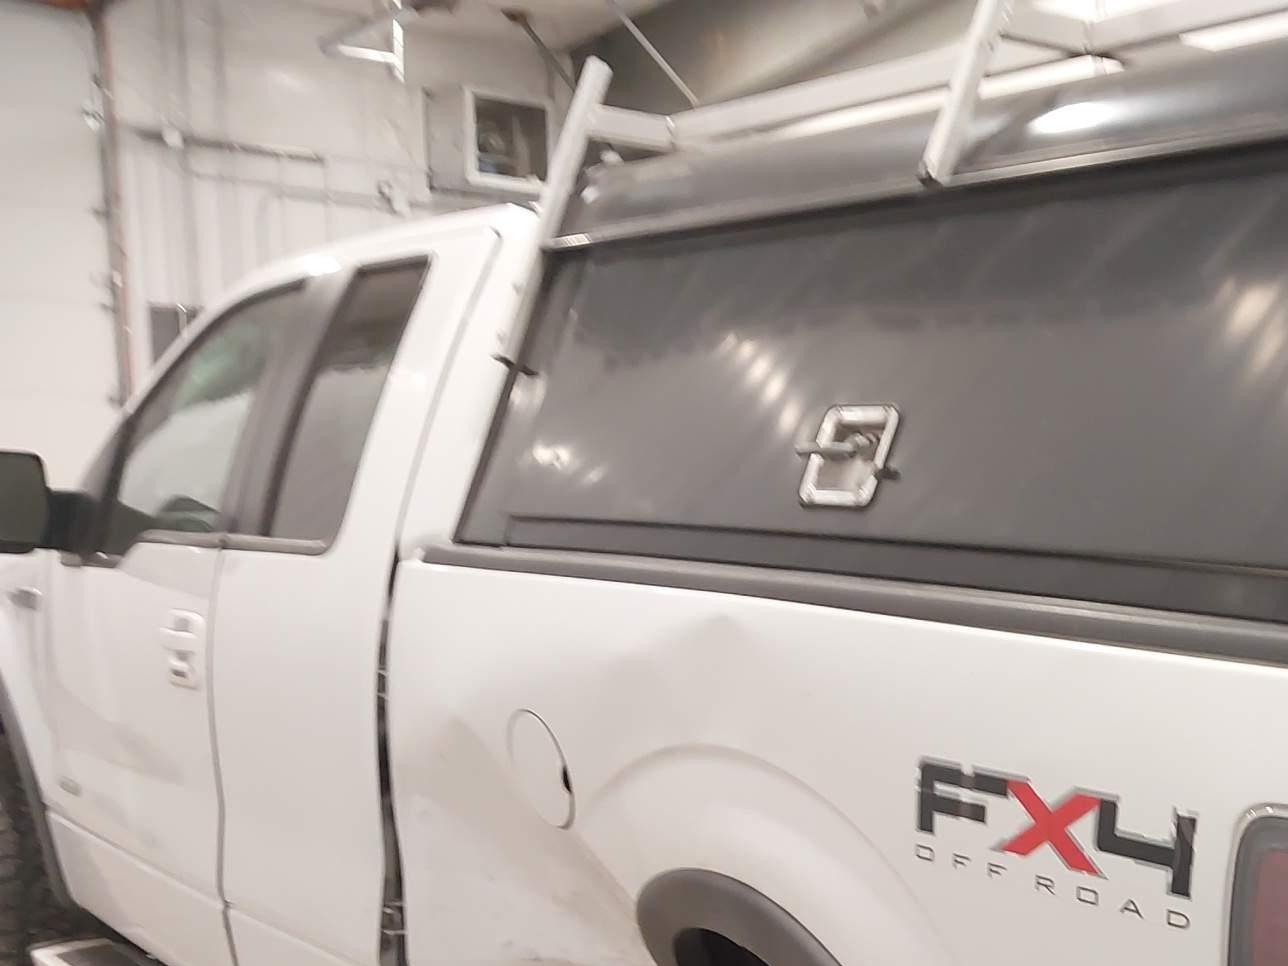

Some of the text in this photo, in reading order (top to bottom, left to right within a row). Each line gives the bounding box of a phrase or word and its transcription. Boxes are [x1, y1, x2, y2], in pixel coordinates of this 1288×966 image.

[917, 756, 1199, 901] FX4
[915, 844, 1191, 929] OFF ROAD
